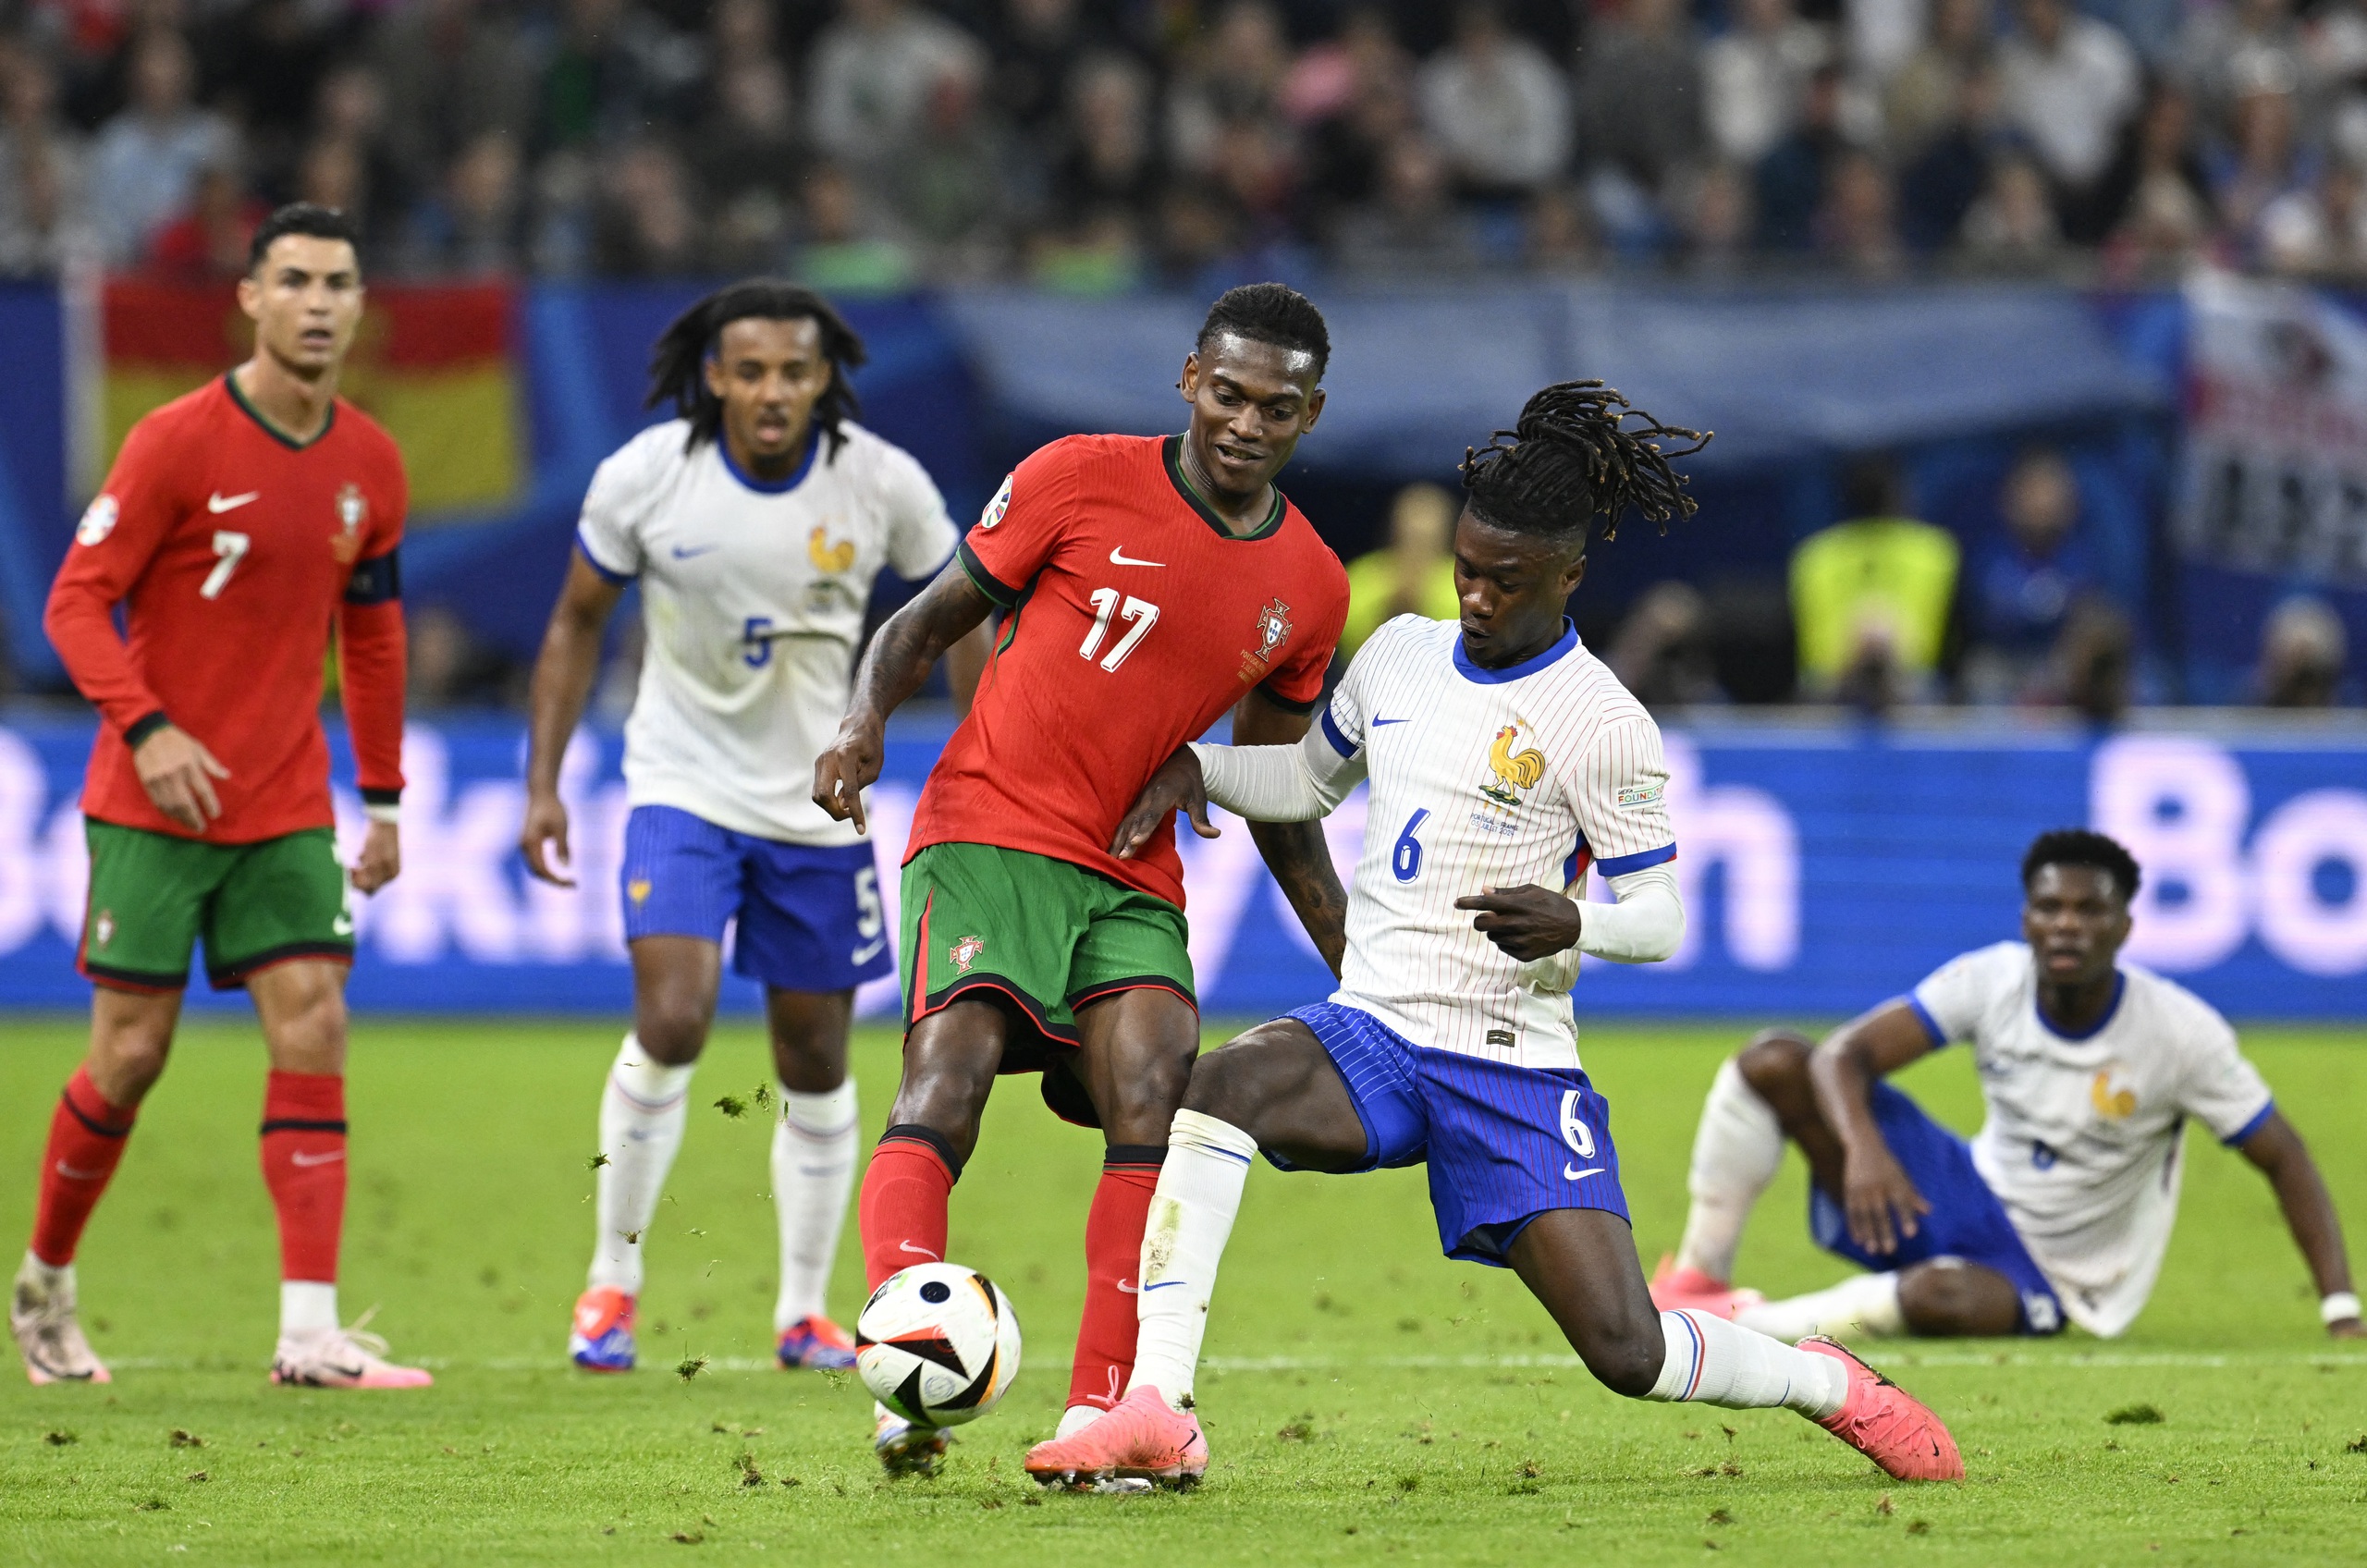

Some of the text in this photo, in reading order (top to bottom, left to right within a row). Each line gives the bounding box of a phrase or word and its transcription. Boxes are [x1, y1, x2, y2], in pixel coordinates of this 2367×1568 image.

[199, 529, 251, 602] 7
[743, 617, 772, 668] 5
[1079, 587, 1159, 673] 17
[1392, 807, 1430, 884] 6
[1471, 813, 1494, 826] PORTUGAL
[1501, 822, 1519, 832] FRANCE
[1500, 828, 1515, 837] 2024
[854, 866, 881, 939] 5
[1560, 1089, 1595, 1159] 6
